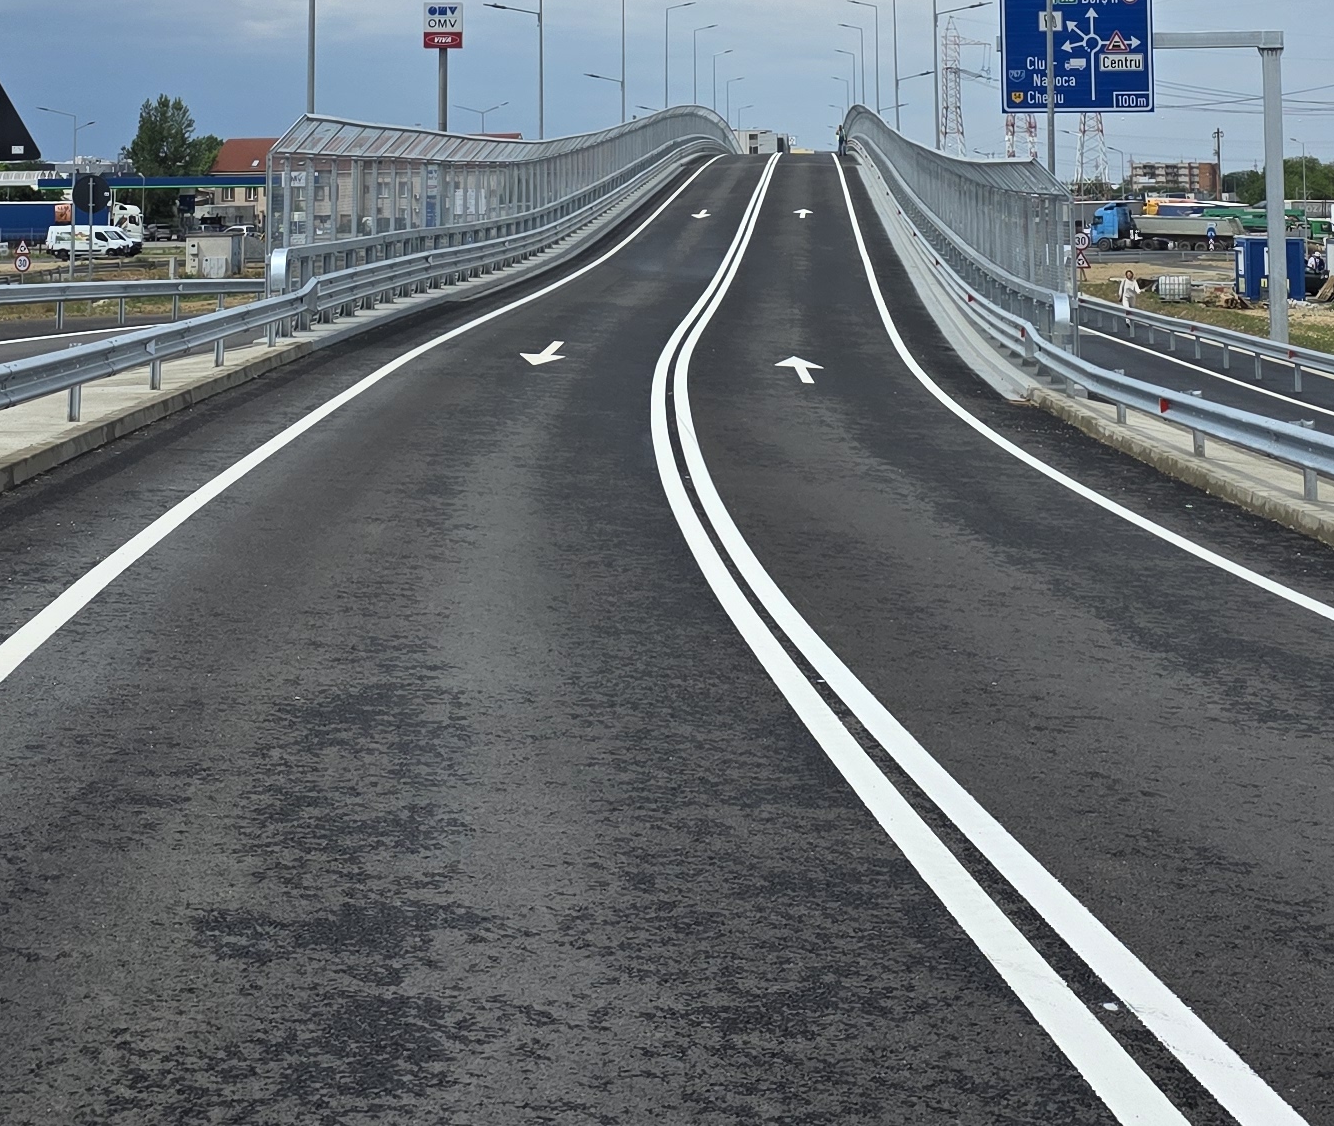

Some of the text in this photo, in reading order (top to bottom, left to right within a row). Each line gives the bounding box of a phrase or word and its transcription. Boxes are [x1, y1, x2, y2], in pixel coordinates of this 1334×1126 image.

[428, 19, 457, 28] OMV
[1027, 56, 1057, 74] Clu-
[1103, 56, 1141, 69] Centru
[1033, 73, 1076, 87] Naoca
[1027, 90, 1064, 104] Cheiu
[1075, 236, 1086, 246] 30
[17, 258, 27, 268] 30
